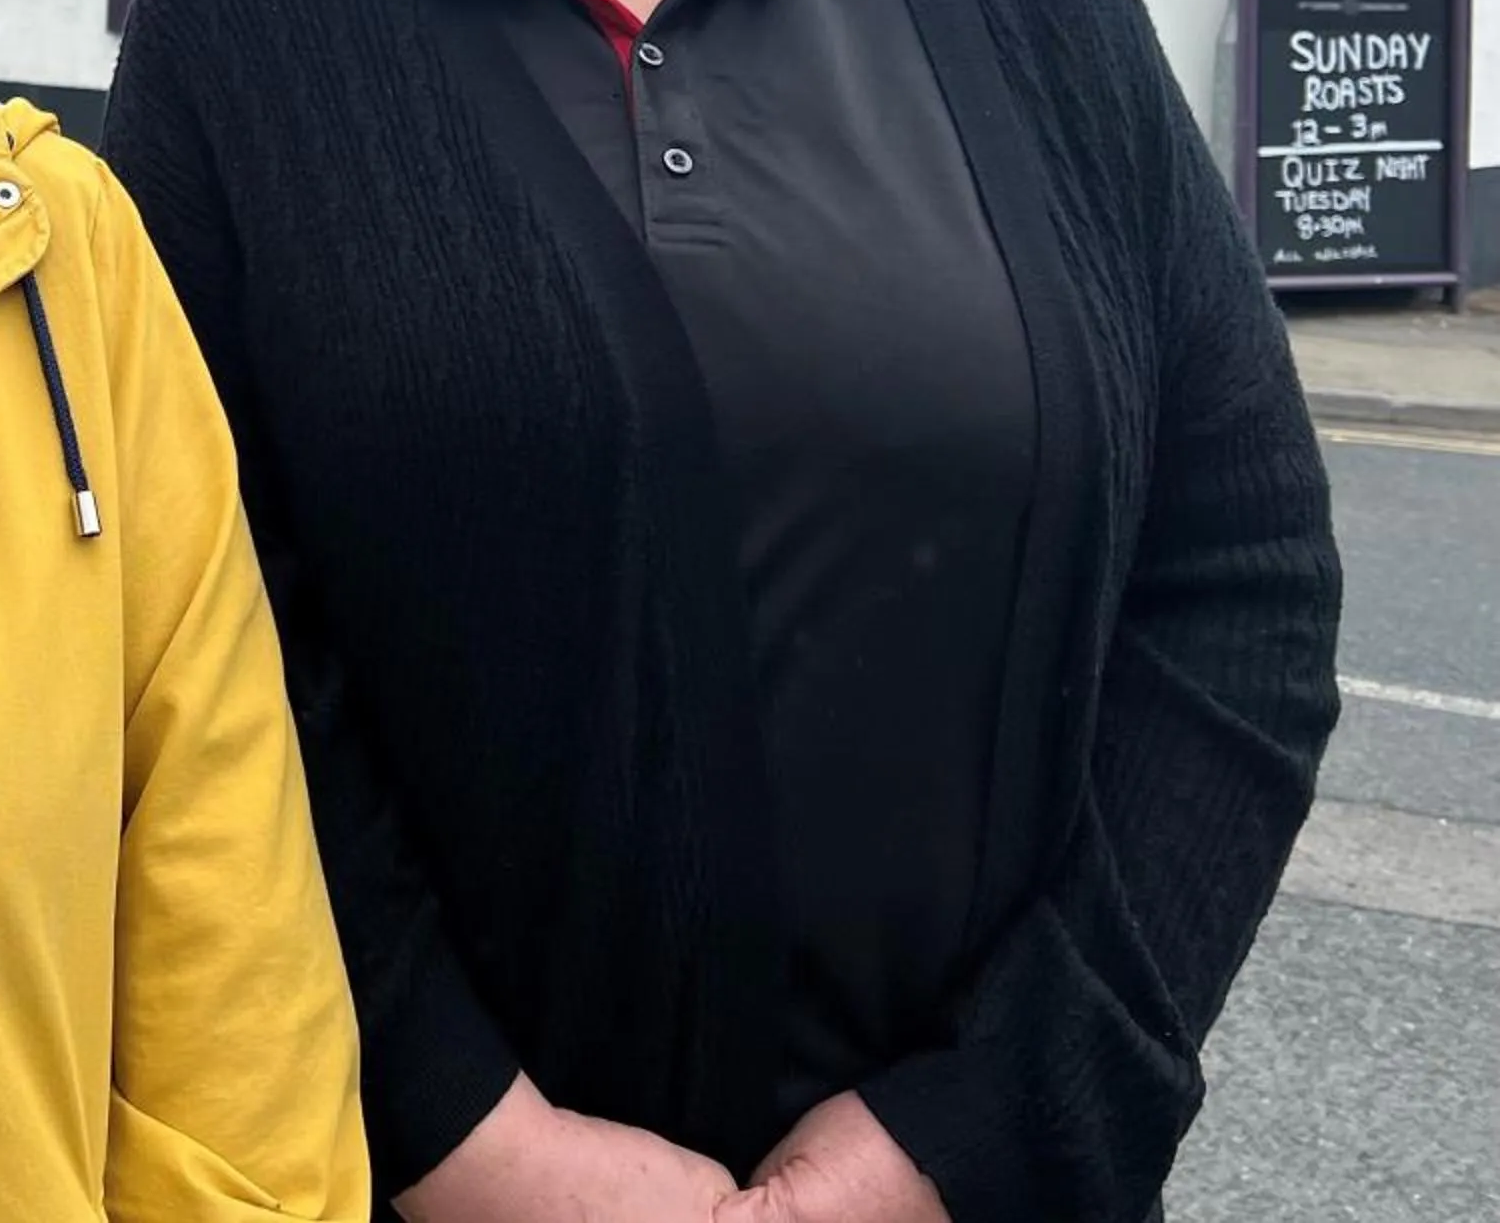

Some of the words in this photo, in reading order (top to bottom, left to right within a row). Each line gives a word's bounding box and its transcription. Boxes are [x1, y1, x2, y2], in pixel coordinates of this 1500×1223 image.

[1290, 30, 1431, 74] SUNDAY
[1303, 74, 1405, 111] ROASTS
[1291, 119, 1321, 147] 12
[1282, 156, 1364, 189] QUIZ
[1275, 186, 1371, 213] TUESDAY
